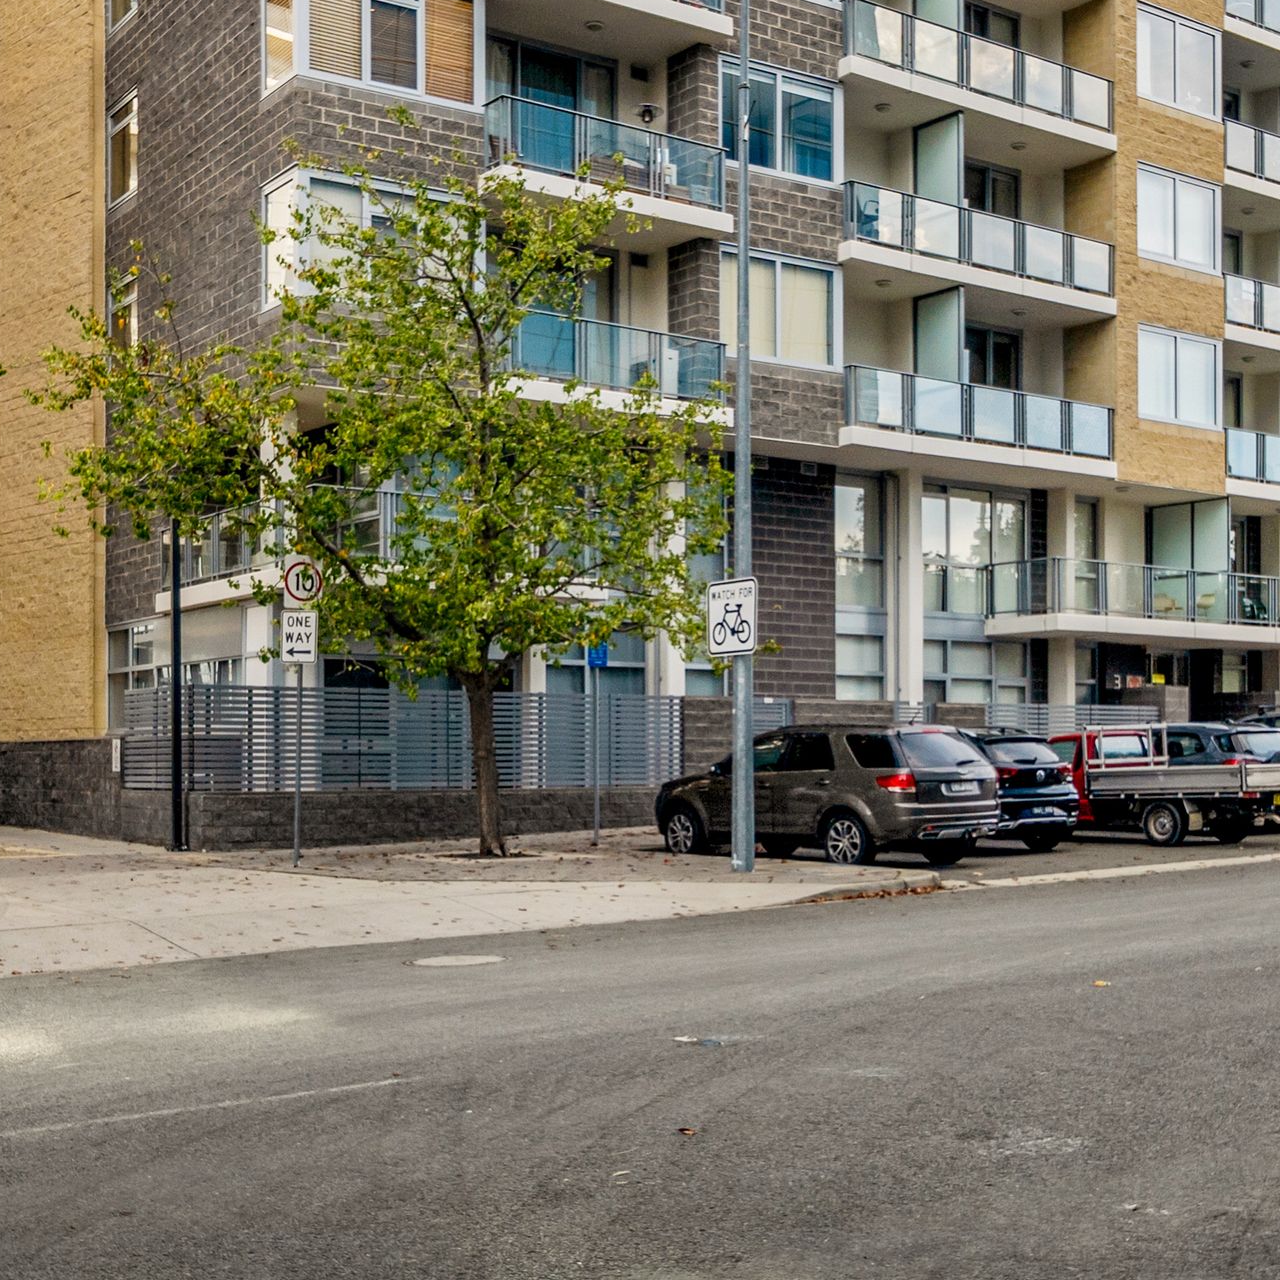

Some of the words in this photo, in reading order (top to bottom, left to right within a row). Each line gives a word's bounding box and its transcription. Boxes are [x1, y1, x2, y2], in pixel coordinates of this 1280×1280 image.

[295, 572, 315, 592] 10
[711, 590, 735, 600] WATCH
[739, 587, 753, 598] FOR
[287, 616, 312, 628] ONE
[285, 632, 312, 644] WAY
